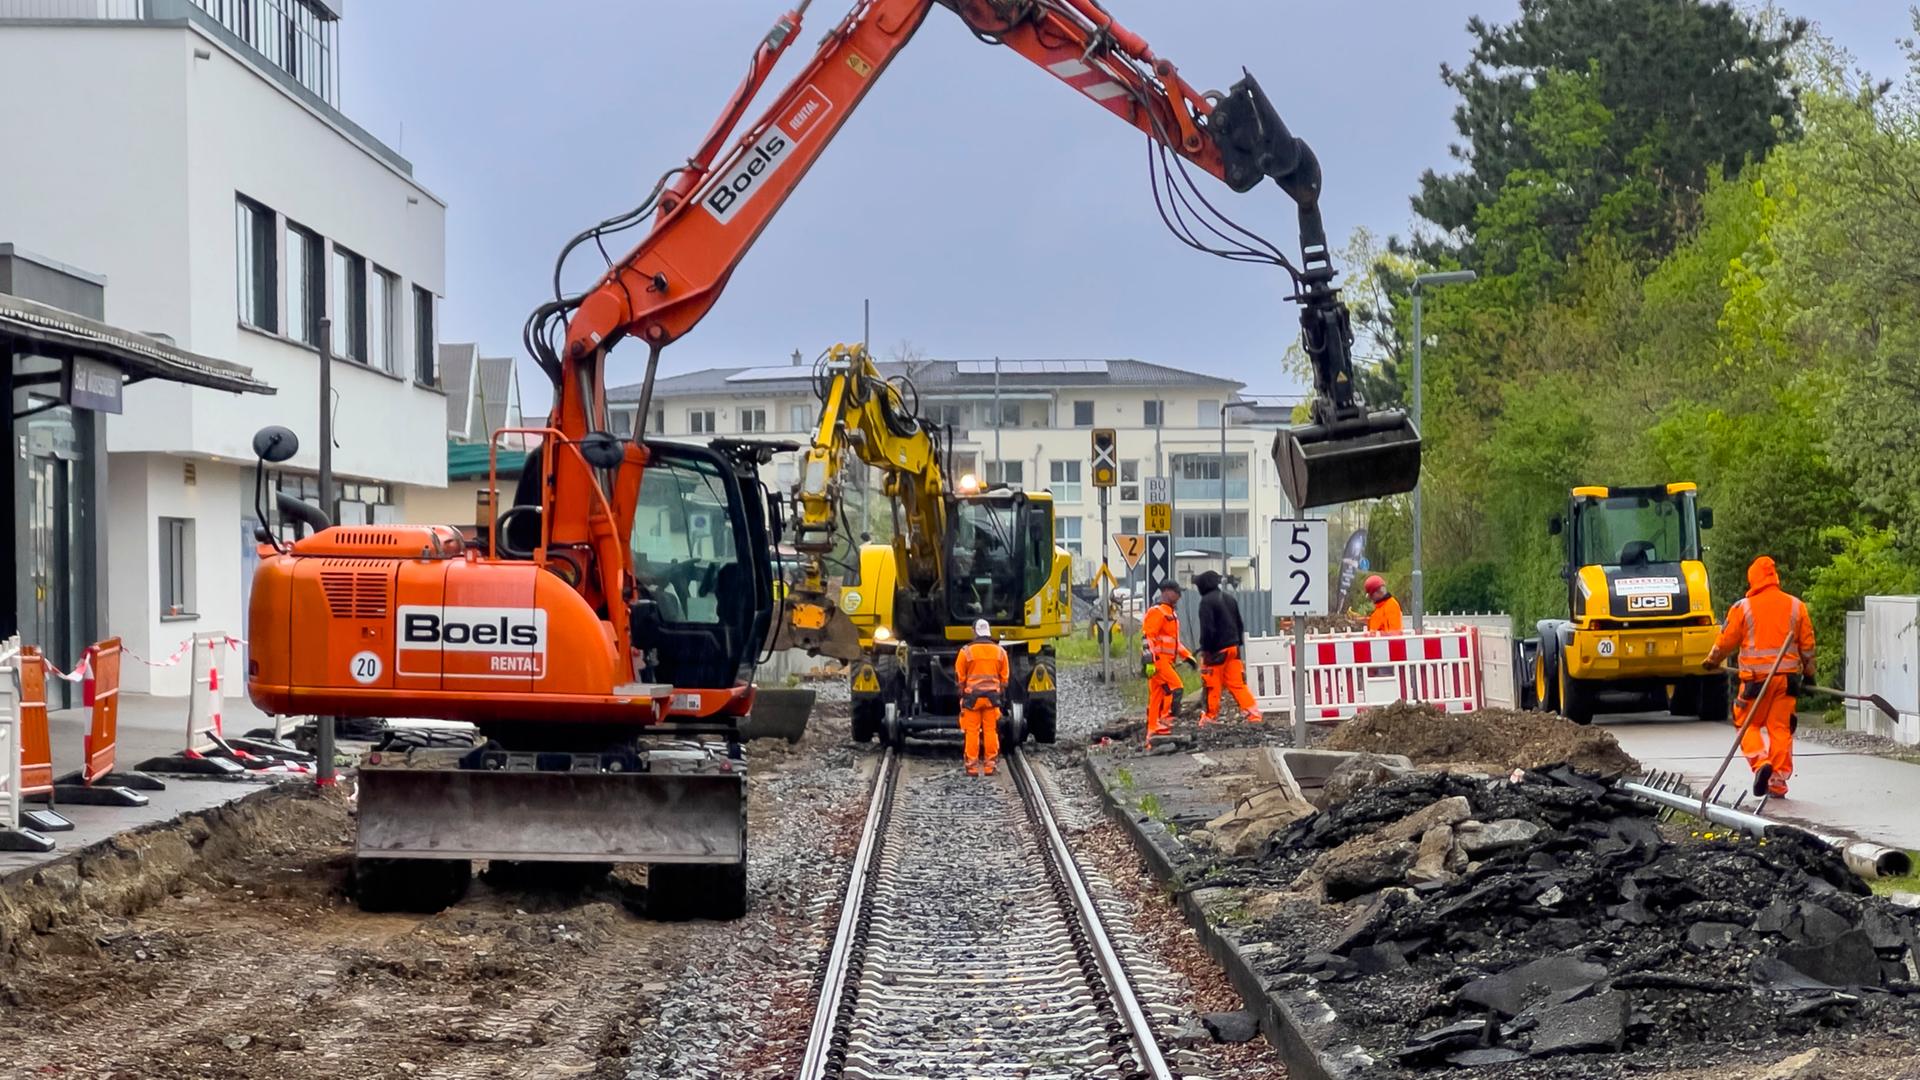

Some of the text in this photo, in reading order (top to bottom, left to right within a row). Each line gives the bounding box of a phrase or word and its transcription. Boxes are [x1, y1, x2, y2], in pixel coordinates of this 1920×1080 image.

[789, 100, 819, 130] RENTAL
[707, 136, 785, 214] Boels
[1128, 537, 1138, 557] 2
[1288, 527, 1312, 564] 5
[1289, 569, 1311, 605] 2
[1631, 596, 1669, 609] JCB
[404, 613, 538, 646] Boels
[1601, 642, 1612, 654] 20
[357, 658, 376, 677] 20
[490, 655, 541, 672] RENTAL
